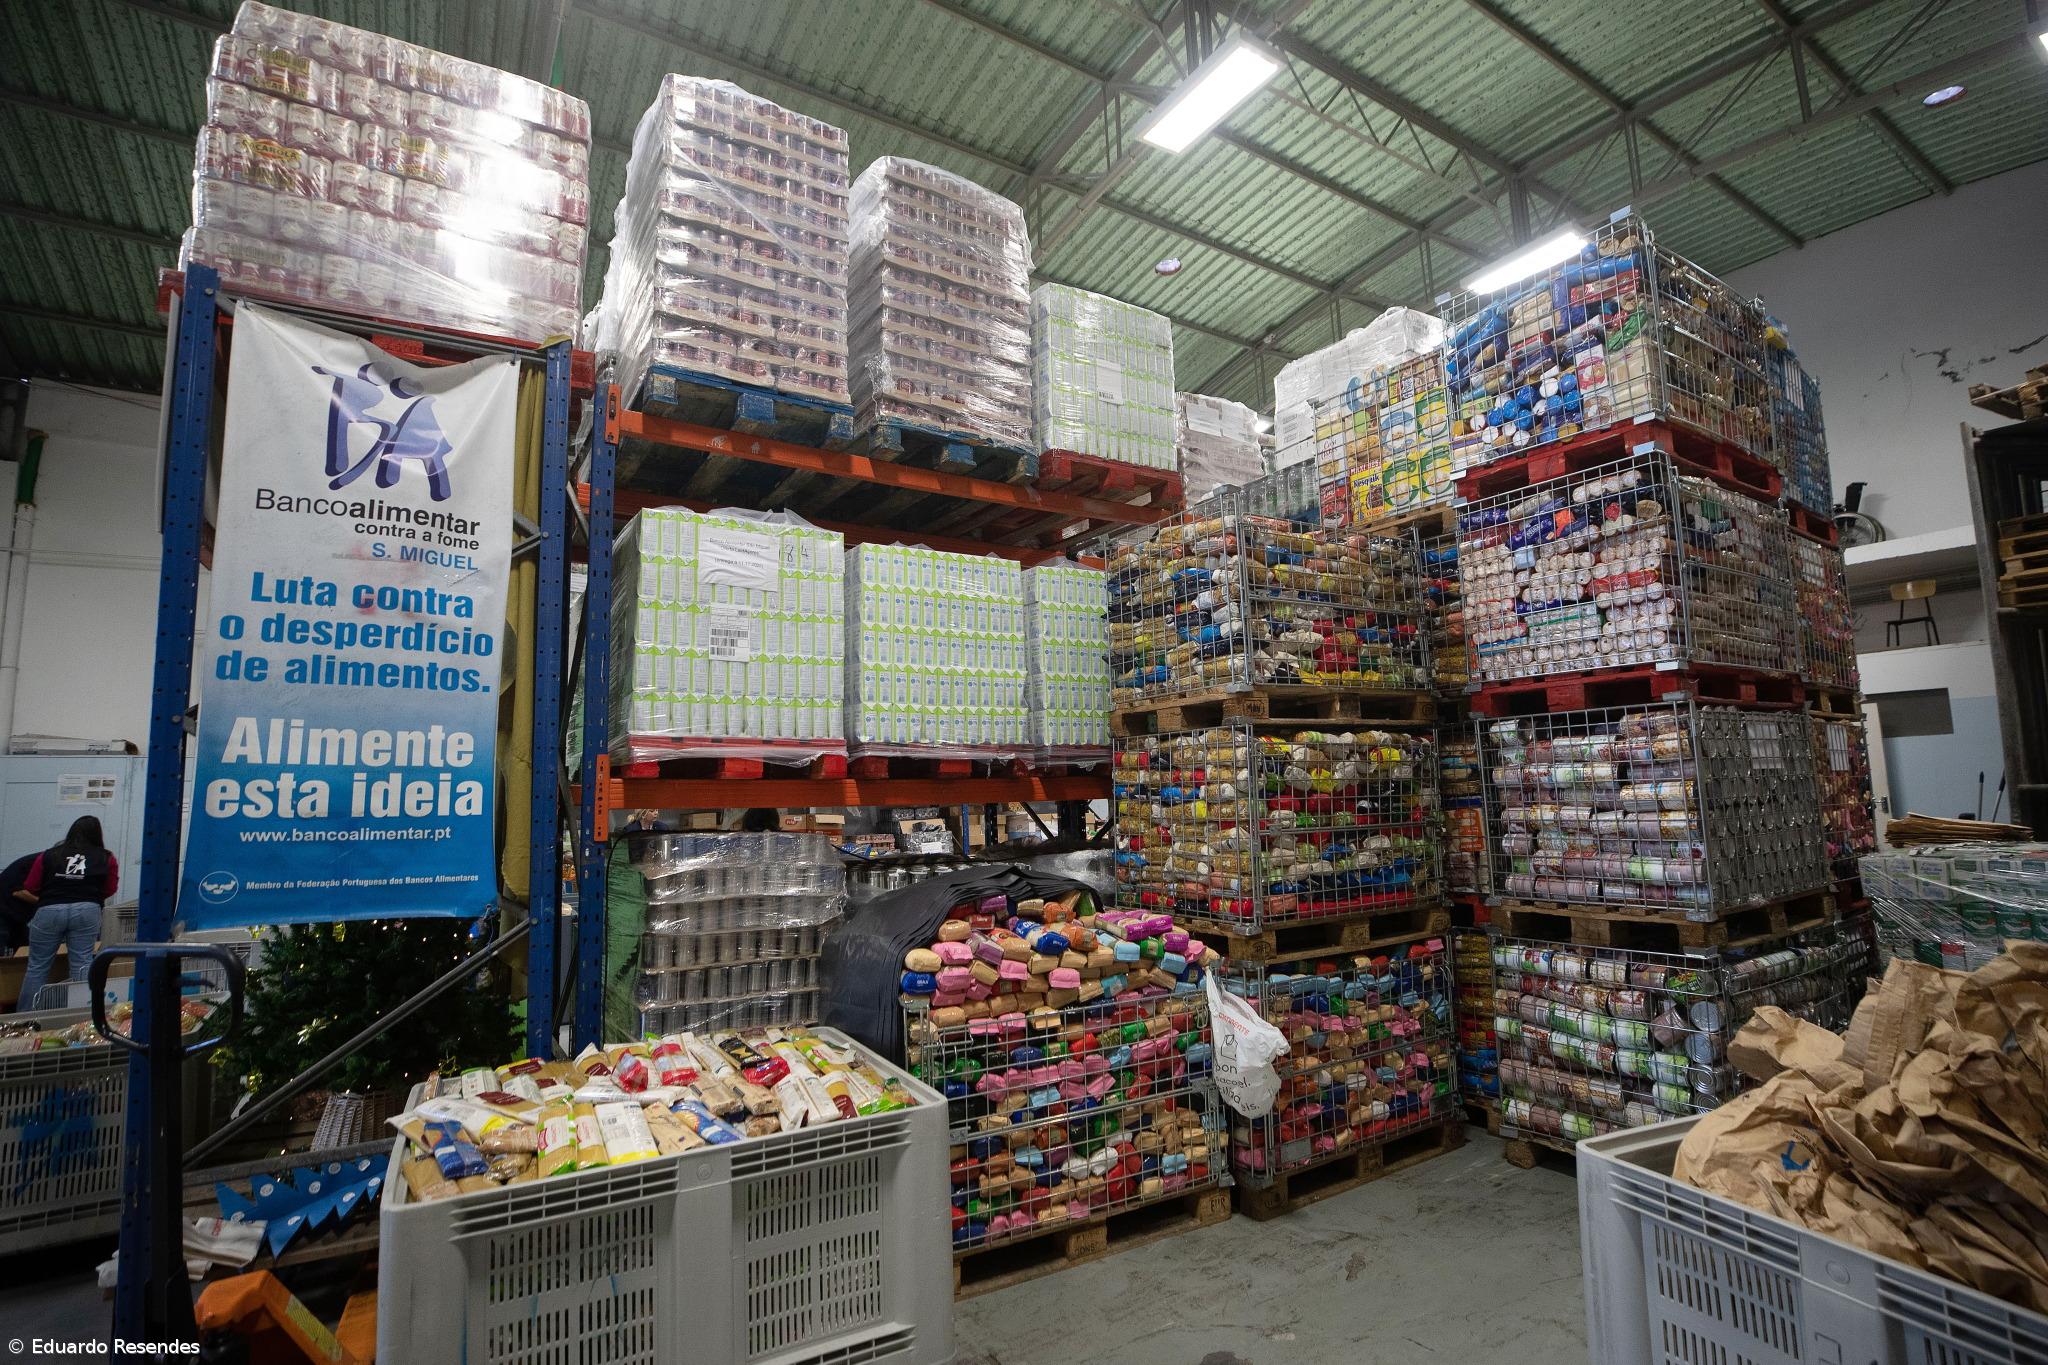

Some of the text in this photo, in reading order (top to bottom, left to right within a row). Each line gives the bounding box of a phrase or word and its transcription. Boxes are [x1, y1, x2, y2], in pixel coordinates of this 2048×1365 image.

[256, 488, 481, 537] Bancoalimentar
[354, 523, 480, 551] contra a fome
[372, 542, 478, 571] S. MIGUEL
[251, 571, 474, 619] Luta contra
[219, 612, 494, 658] o desperdício
[215, 650, 491, 694] de alimentos.
[221, 716, 475, 768] Alimente
[204, 772, 484, 819] esta ideia
[240, 825, 452, 843] www.bancoalimentar.pt
[246, 874, 478, 890] Membro da Federação Portuguesa dos Bancos Alimentares
